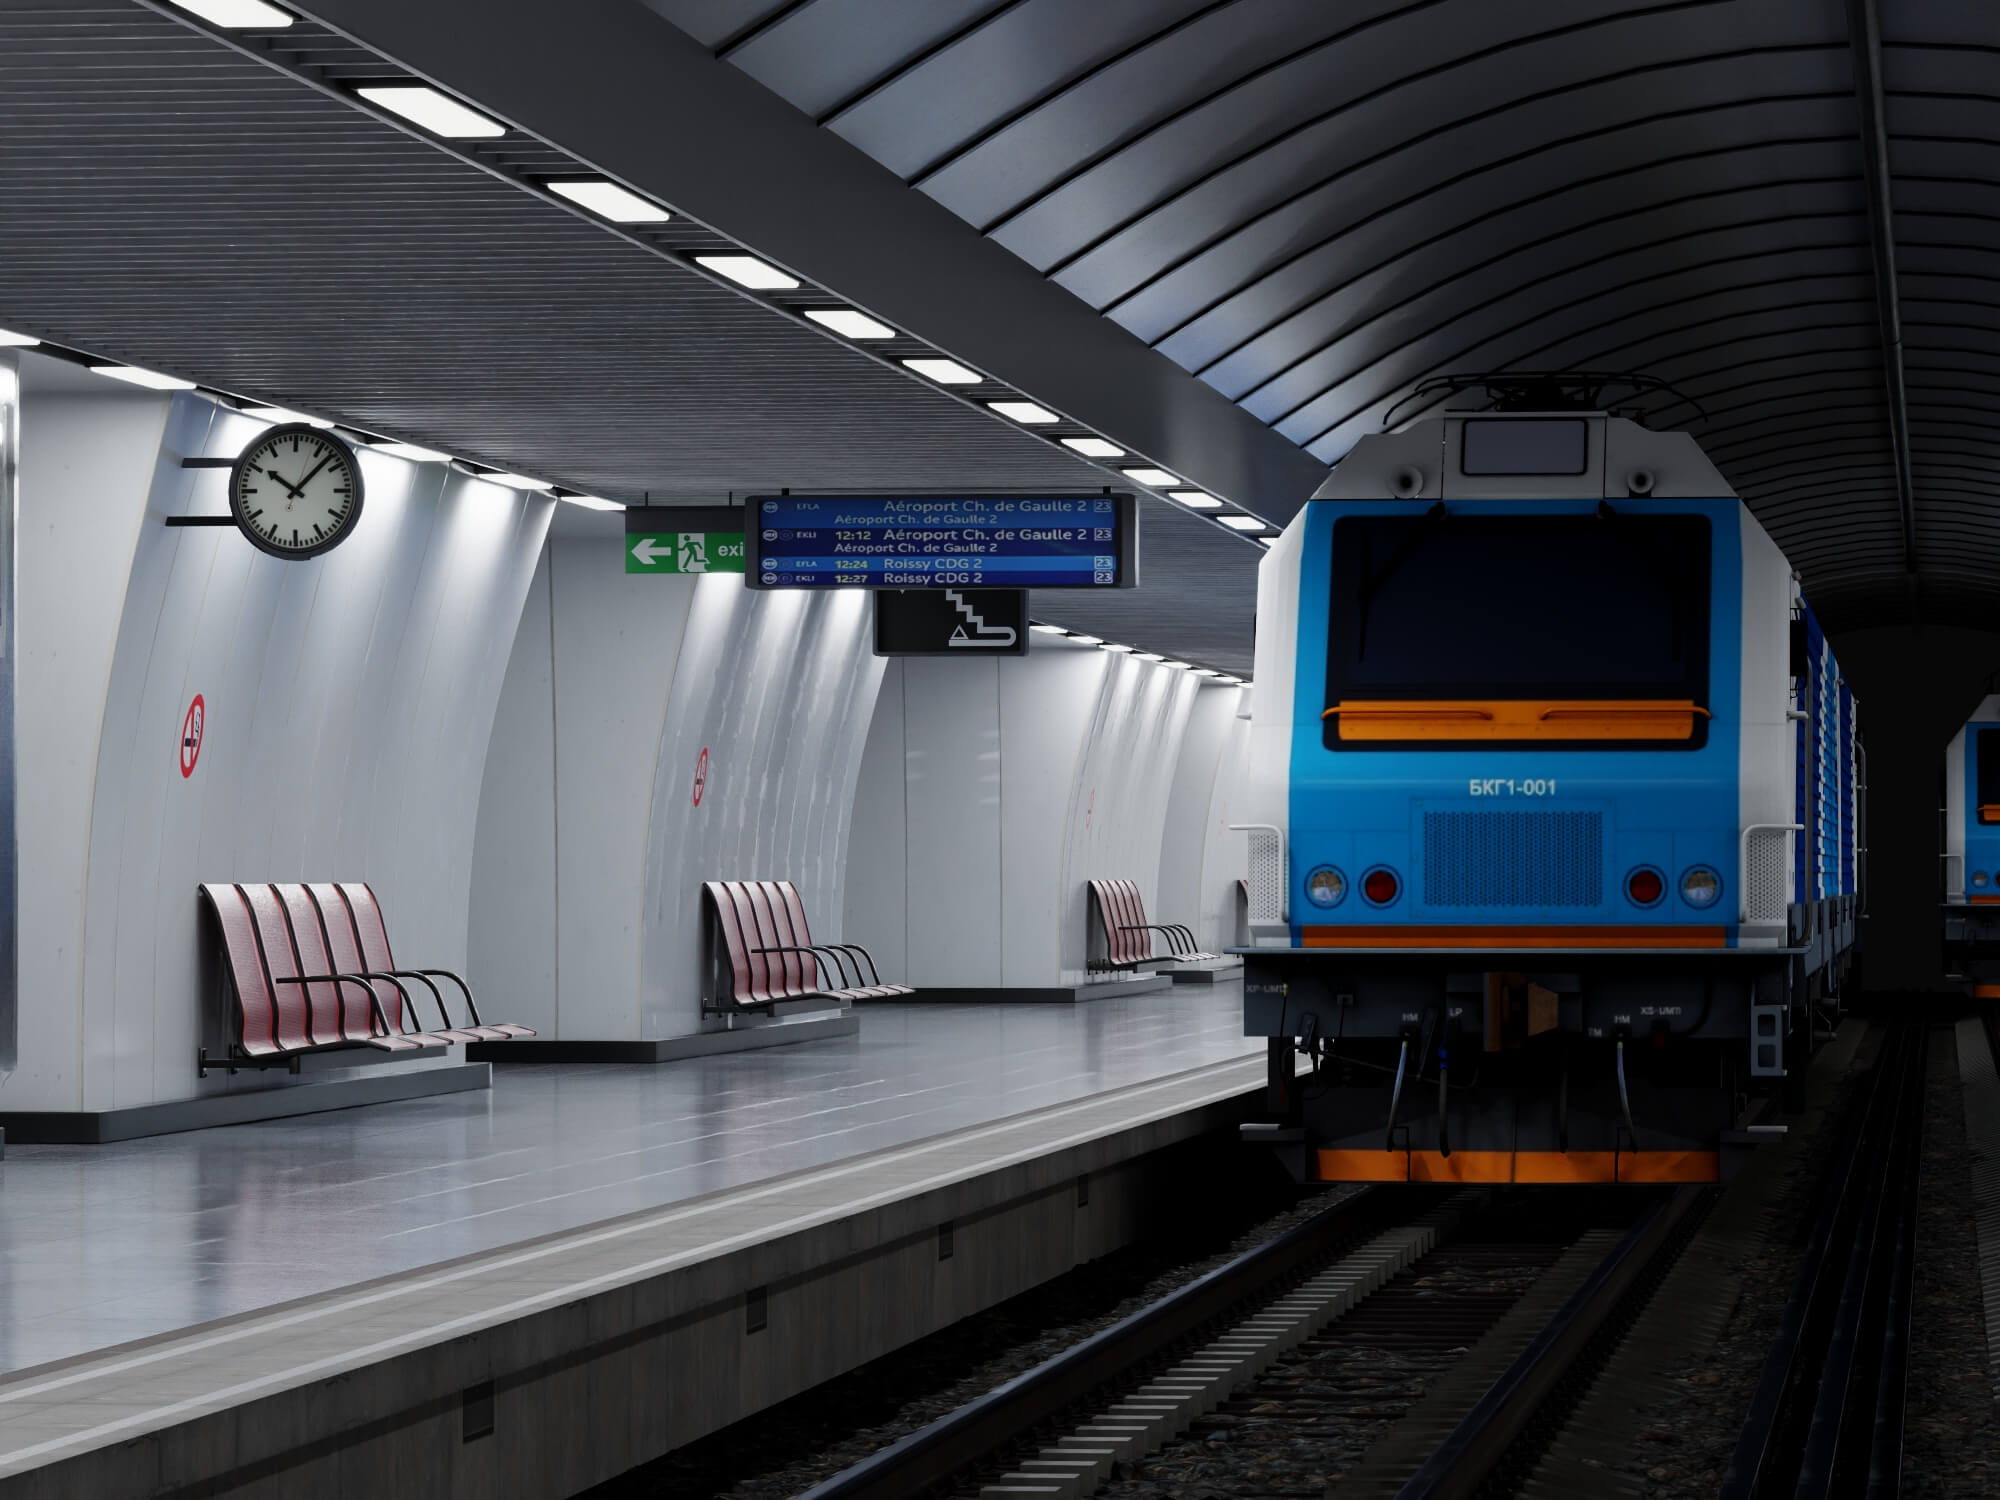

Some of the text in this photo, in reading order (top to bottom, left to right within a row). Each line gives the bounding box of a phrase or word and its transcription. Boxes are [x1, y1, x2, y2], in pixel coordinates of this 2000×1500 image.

[883, 501, 958, 515] Aéroport
[962, 501, 990, 512] Ch.
[994, 501, 1015, 512] de
[1019, 501, 1072, 512] Gaulle
[1077, 501, 1087, 512] 2
[834, 514, 998, 526] Aéroport Ch. de Gaulle 2
[835, 531, 871, 540] 12:12
[883, 529, 958, 543] Aéroport
[962, 529, 990, 540] Ch.
[994, 529, 1015, 540] de
[1019, 529, 1072, 540] Gaulle
[1077, 529, 1087, 540] 2
[1096, 529, 1112, 539] 23
[718, 541, 744, 557] exi
[834, 543, 998, 554] Aéroport Ch. de Gaulle 2
[834, 560, 868, 569] 12:24
[883, 558, 931, 571] Roissy
[934, 558, 969, 569] CDG
[973, 558, 983, 569] 2
[1096, 559, 1112, 567] 23
[834, 575, 868, 584] 12:27
[883, 572, 931, 586] Roissy
[934, 572, 969, 583] CDG
[973, 572, 983, 583] 2
[1096, 573, 1112, 582] 23
[1469, 779, 1556, 796] БКГ1-001
